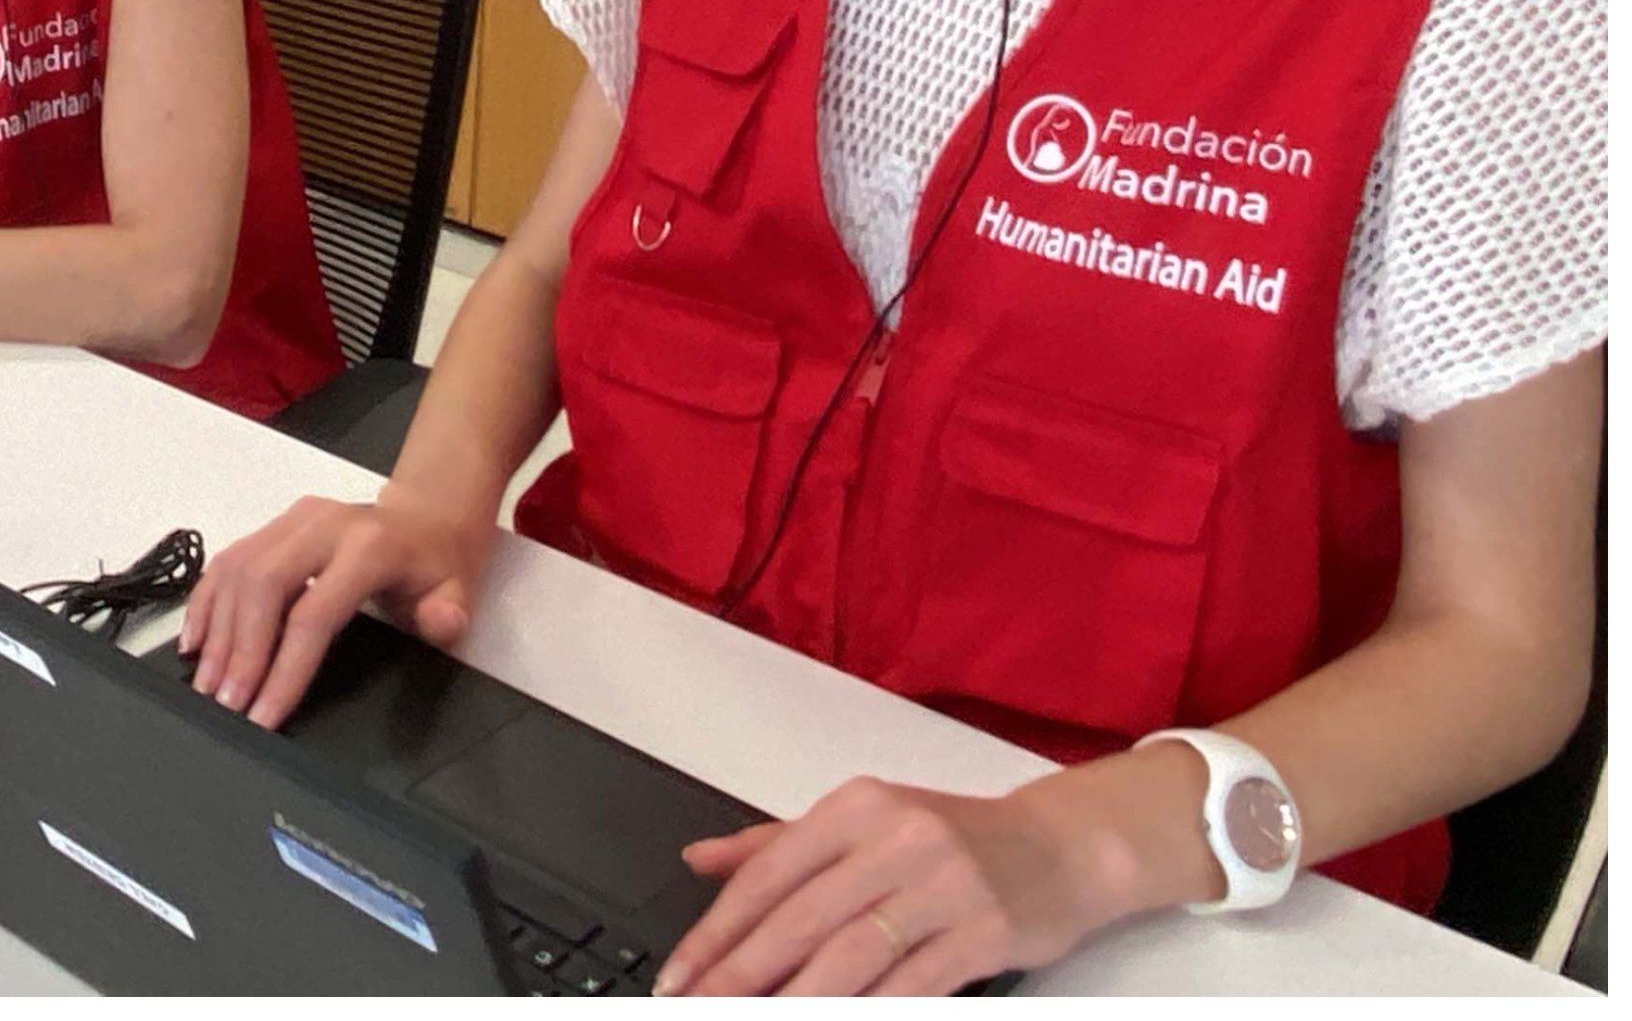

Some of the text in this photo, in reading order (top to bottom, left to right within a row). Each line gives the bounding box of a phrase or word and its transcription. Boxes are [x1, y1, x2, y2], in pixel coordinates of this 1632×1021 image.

[1101, 109, 1313, 178] Fundación
[1077, 154, 1269, 224] Madrina
[975, 195, 1288, 314] Humanitarian Aid
